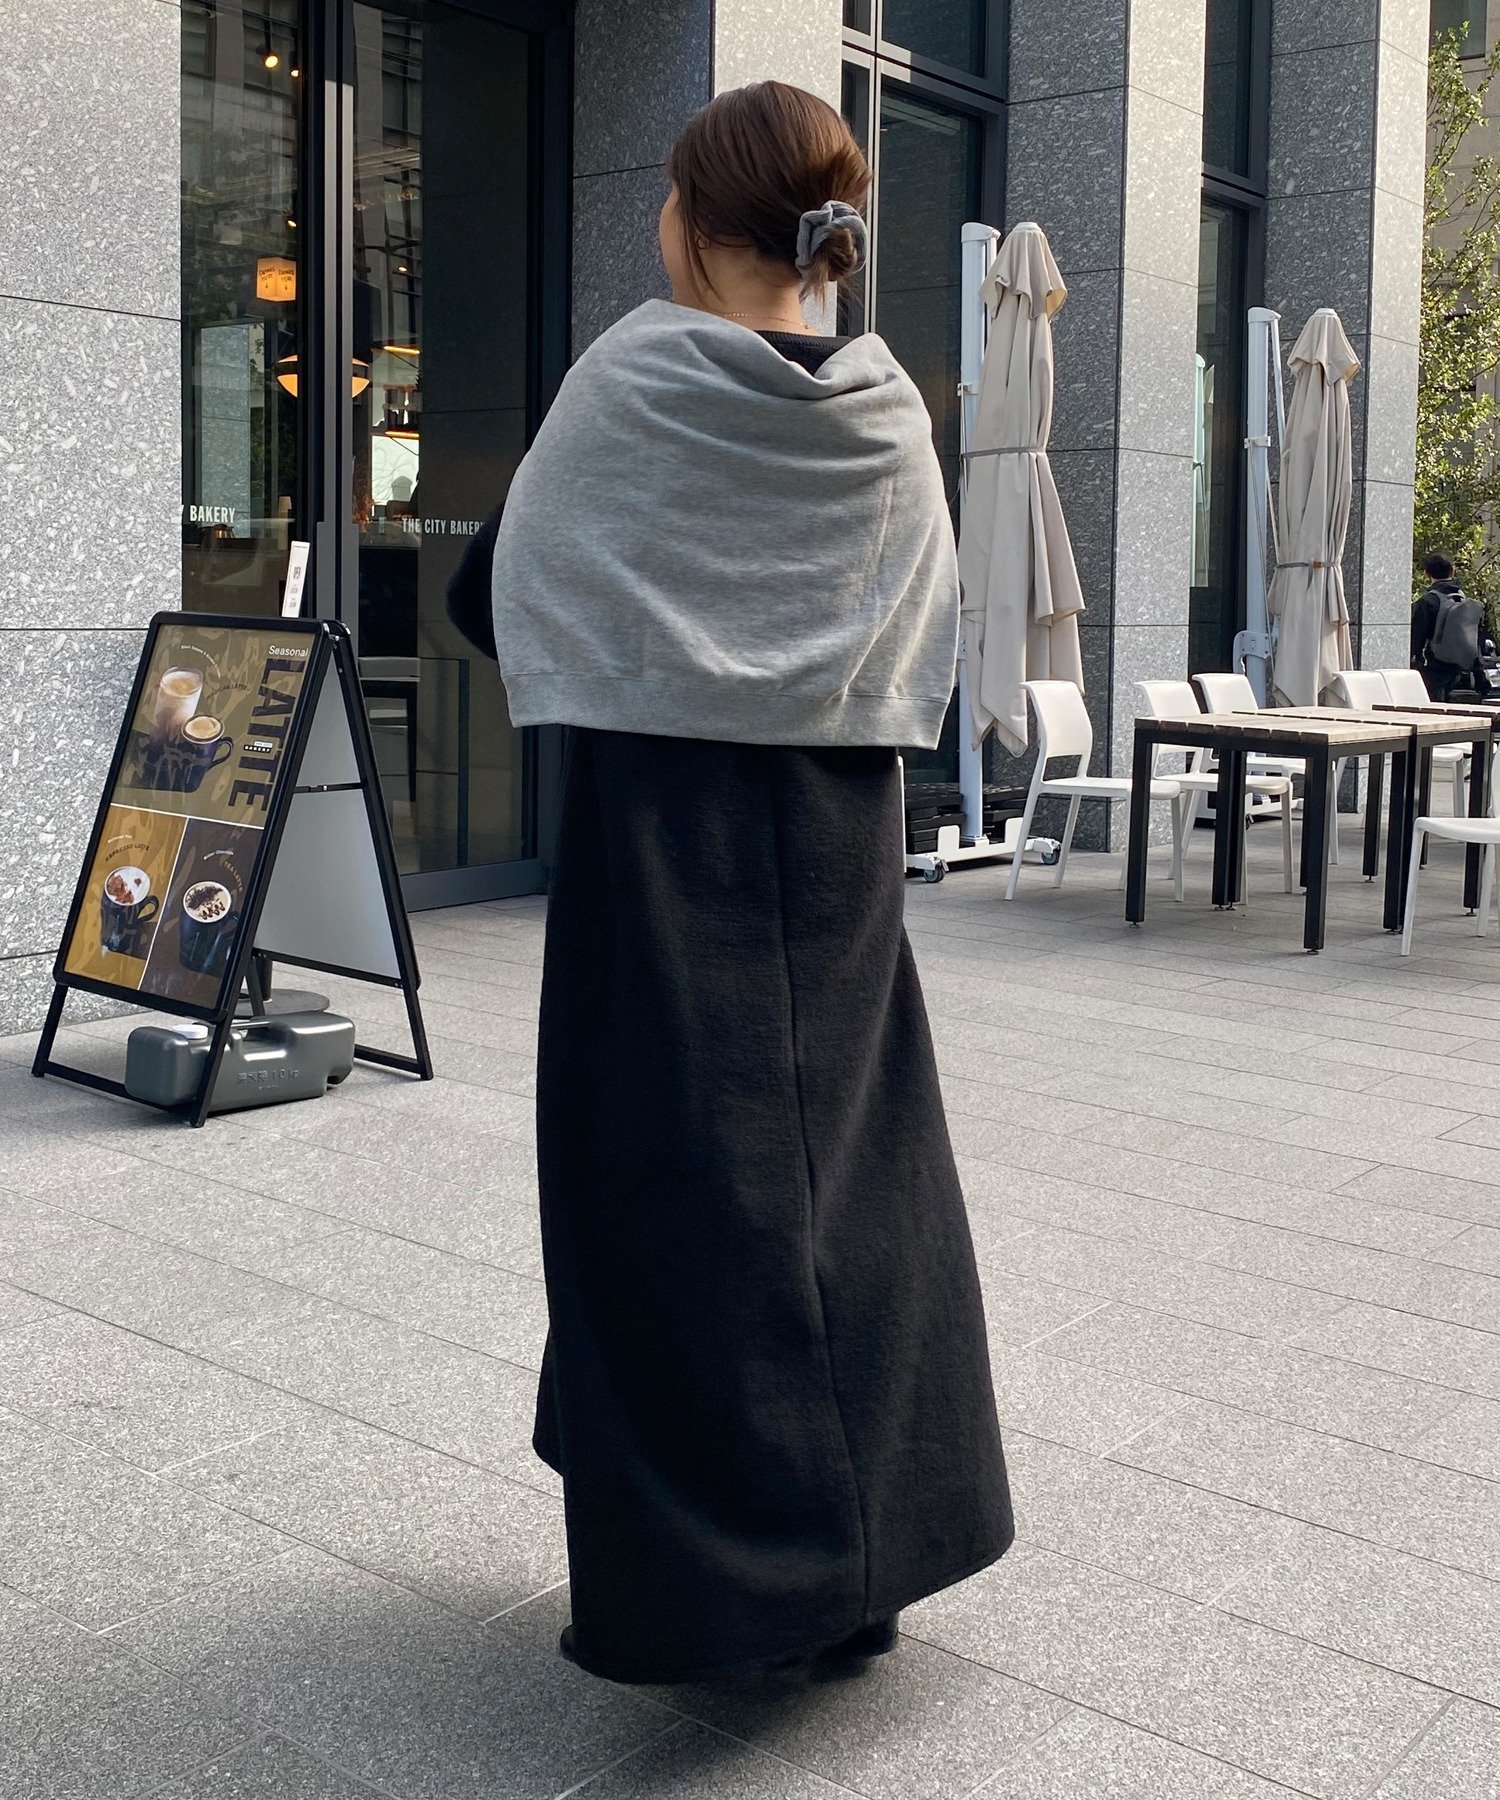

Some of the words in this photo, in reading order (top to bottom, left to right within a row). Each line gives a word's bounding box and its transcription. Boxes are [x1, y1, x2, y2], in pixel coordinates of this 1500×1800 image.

[190, 505, 236, 523] BAKERY
[401, 517, 421, 533] THE
[424, 518, 448, 534] CITY
[268, 645, 309, 657] Seasonal
[228, 658, 306, 812] LATTE
